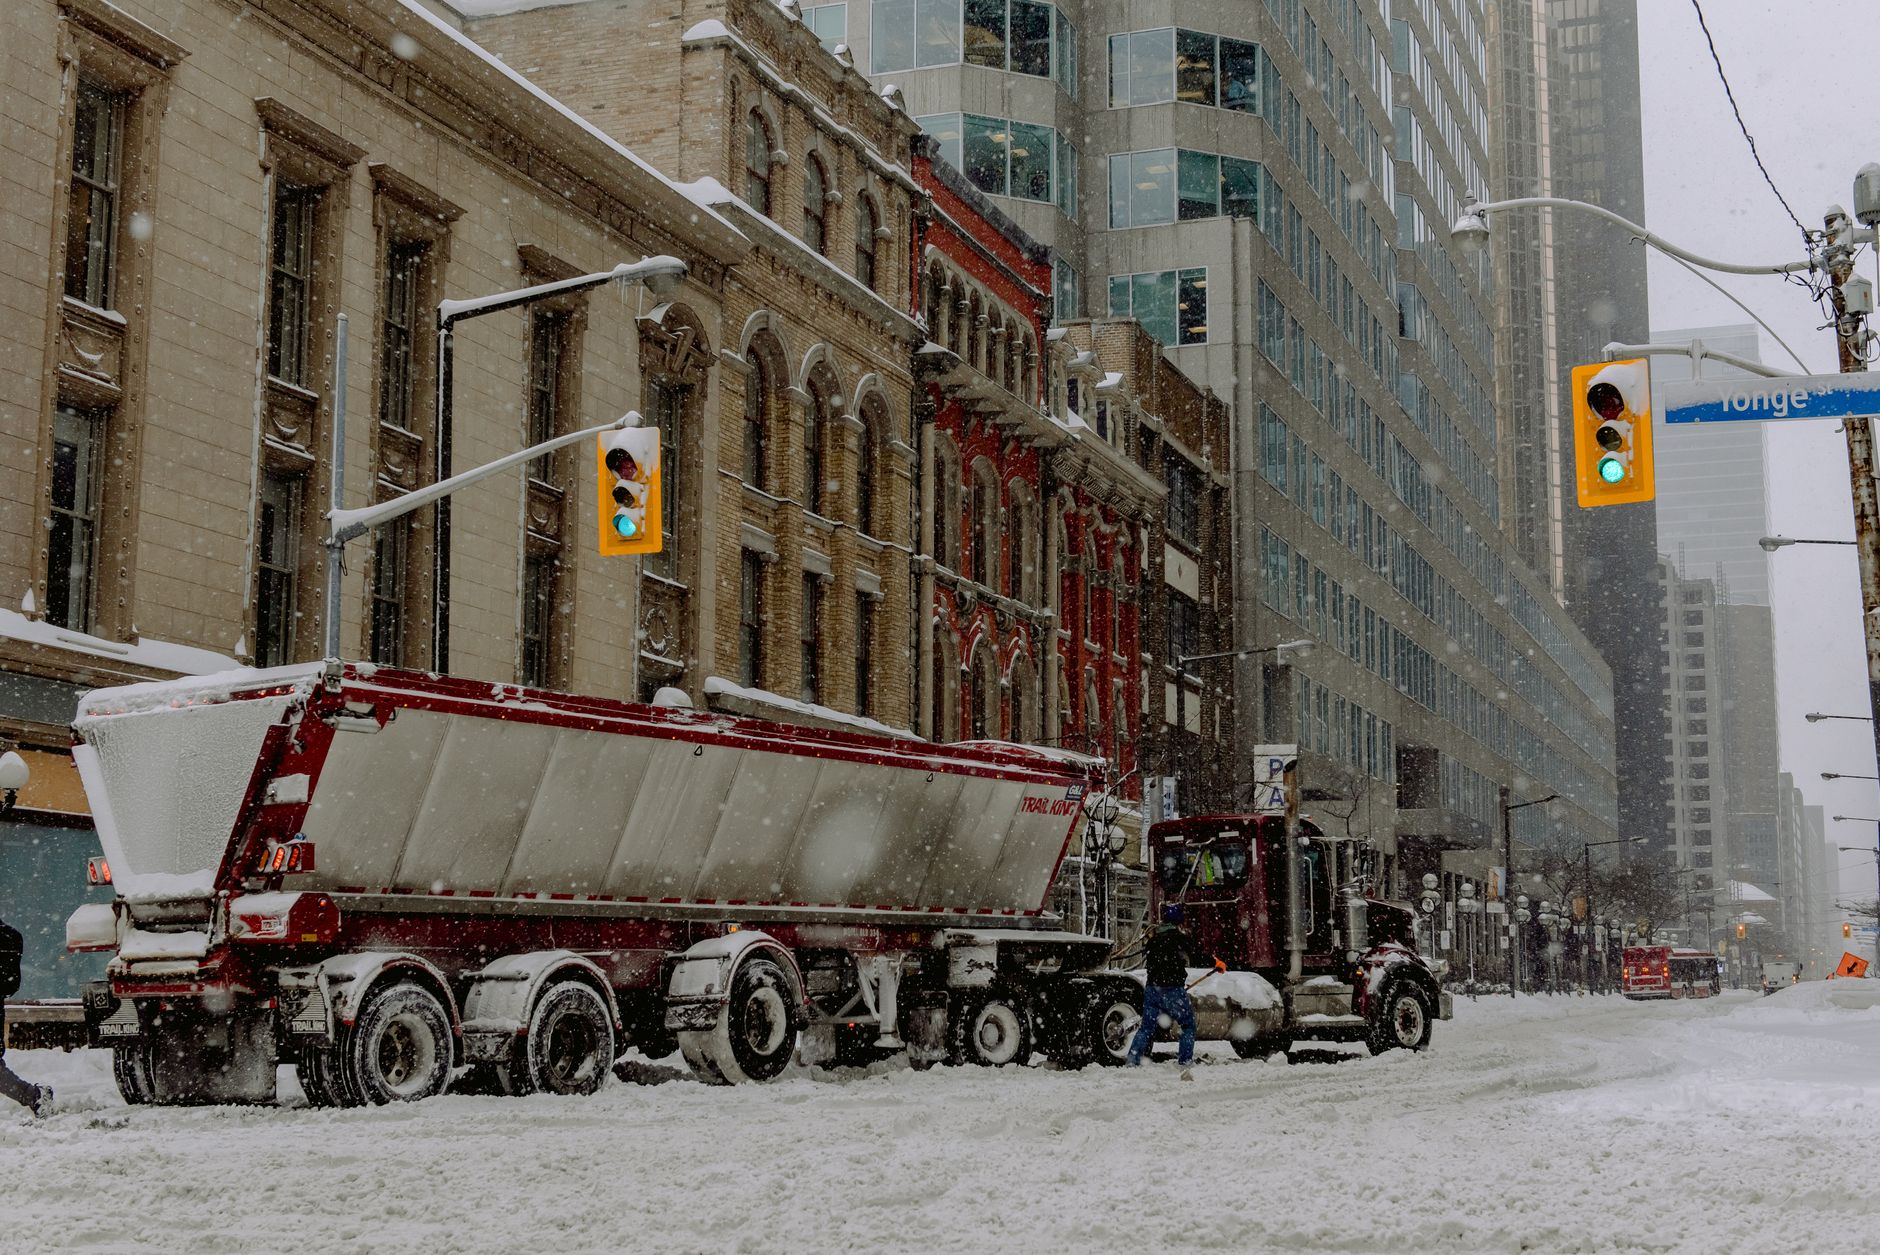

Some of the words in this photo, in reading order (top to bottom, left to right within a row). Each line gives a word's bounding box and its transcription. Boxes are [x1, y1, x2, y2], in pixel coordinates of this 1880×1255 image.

[1718, 386, 1808, 417] Yonge
[1021, 796, 1049, 814] TRAIL
[1049, 799, 1077, 817] KING
[98, 1025, 123, 1035] TRAIL
[292, 1021, 312, 1032] TRAIL
